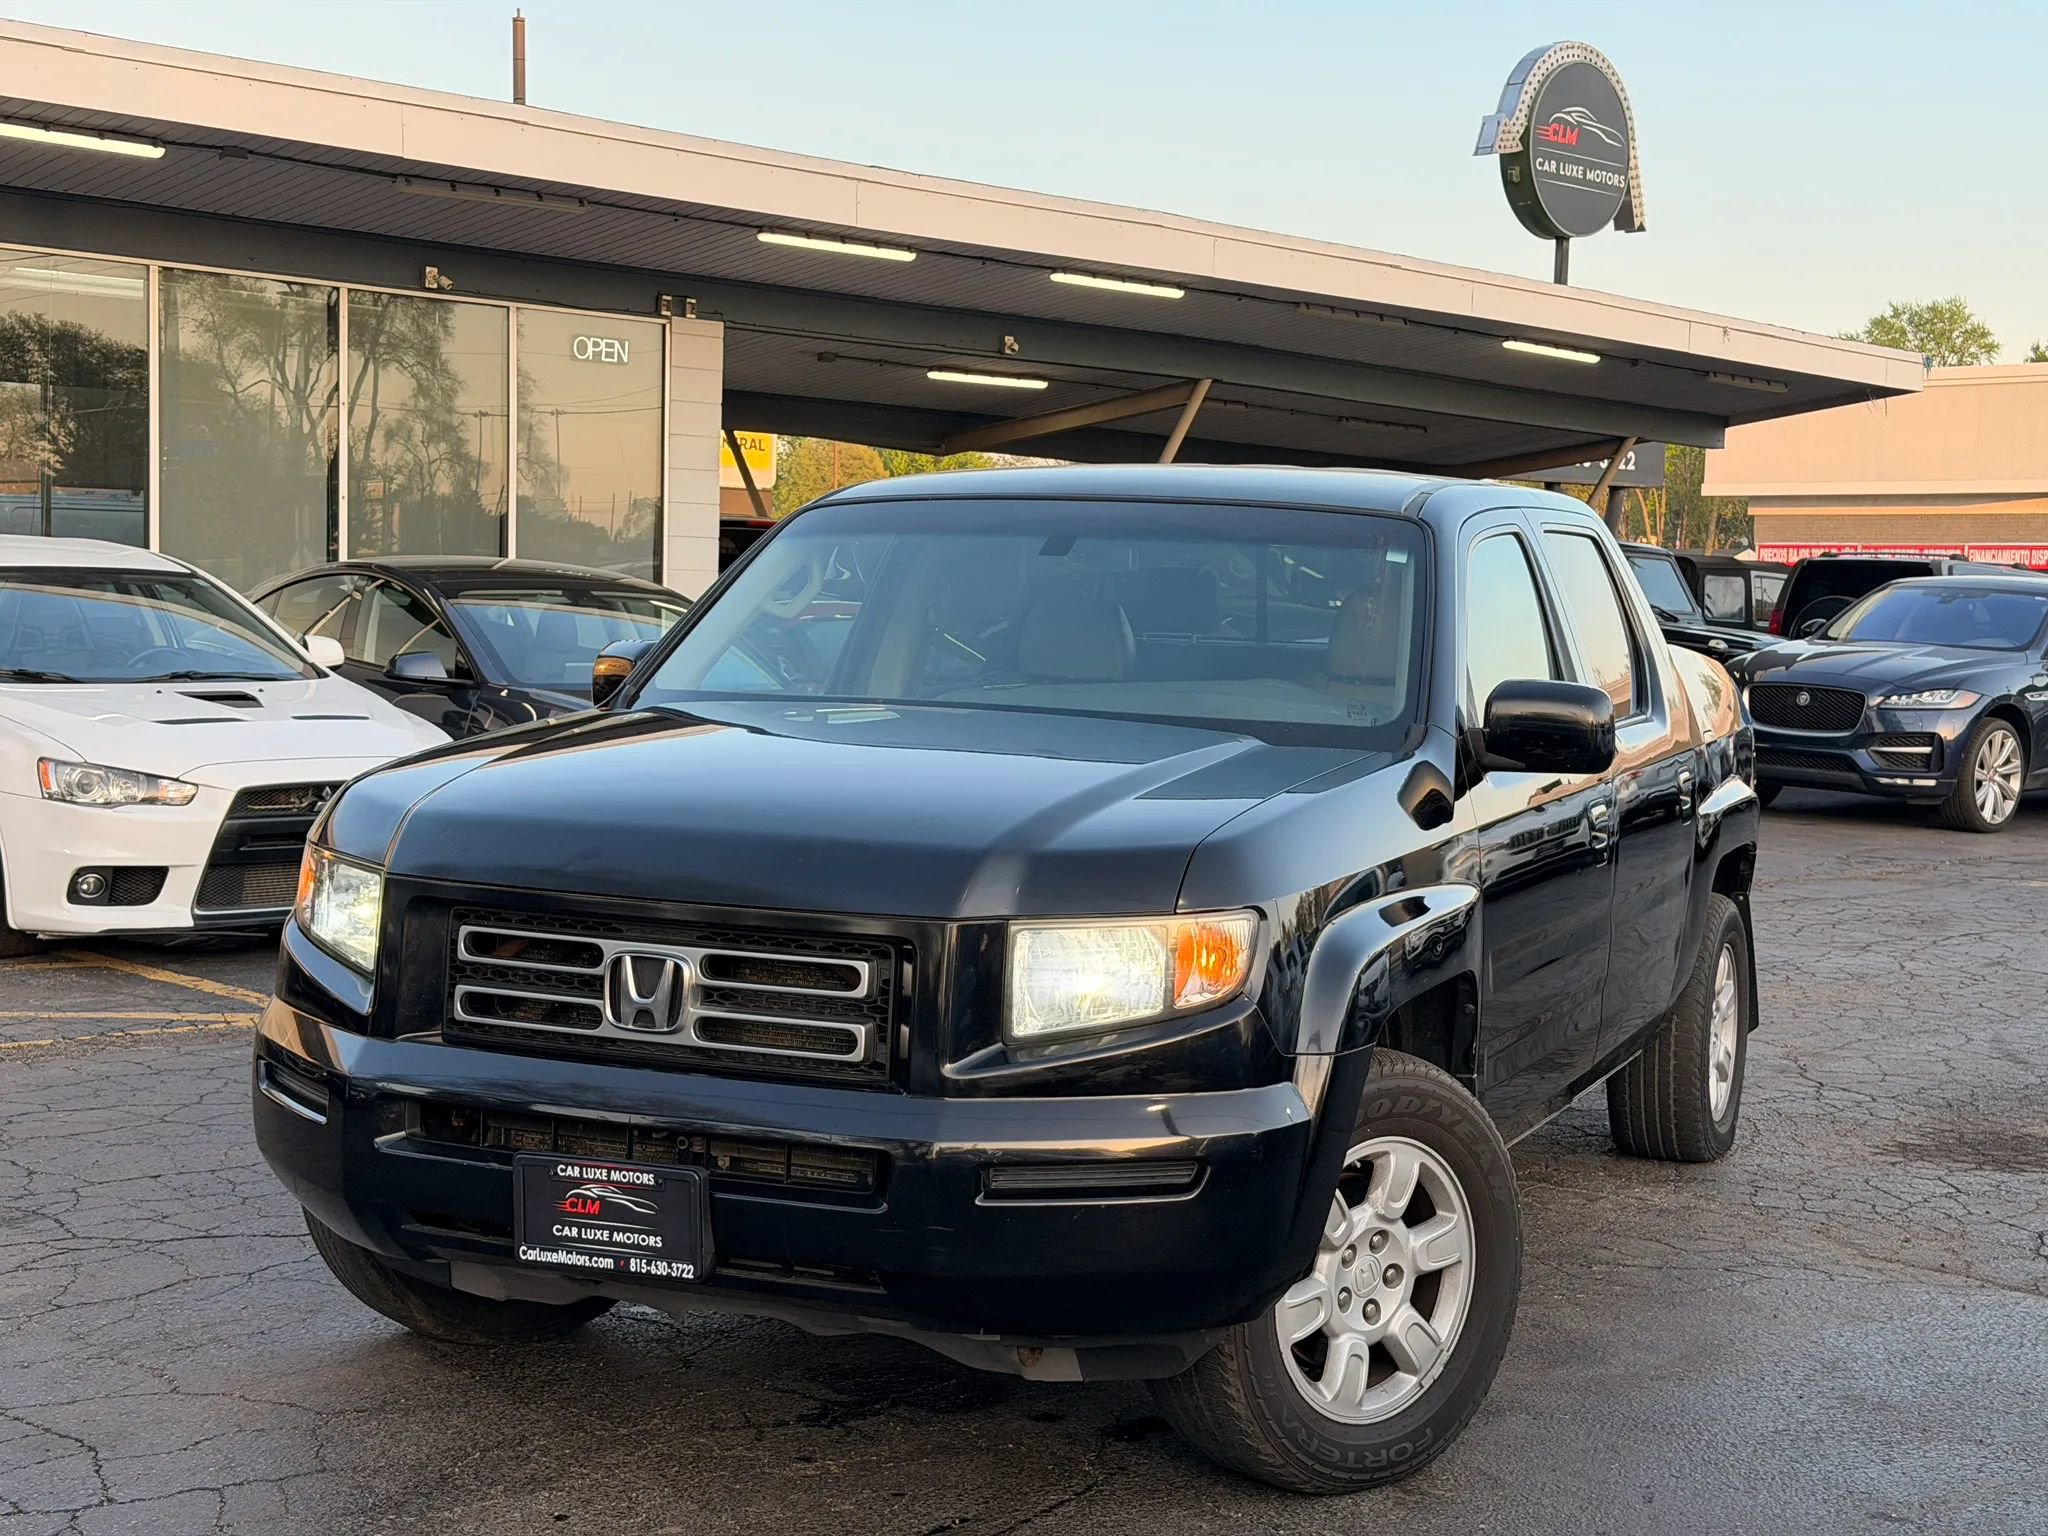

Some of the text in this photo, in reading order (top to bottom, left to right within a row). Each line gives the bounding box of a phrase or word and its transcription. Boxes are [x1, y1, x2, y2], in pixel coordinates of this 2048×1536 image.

[1549, 123, 1580, 146] CLM
[1535, 157, 1625, 188] CAR LUXE MOTORS
[573, 336, 630, 363] OPEN
[1759, 547, 1788, 563] PRECIOS
[1968, 548, 2031, 566] FINANCIAMIENTO
[556, 1164, 655, 1186] CAR LUXE MOTORS
[565, 1197, 601, 1216] CLM
[552, 1224, 663, 1248] CAR LUXE MOTORS
[519, 1245, 695, 1279] CarLuxeMotors.com 815-630-3722
